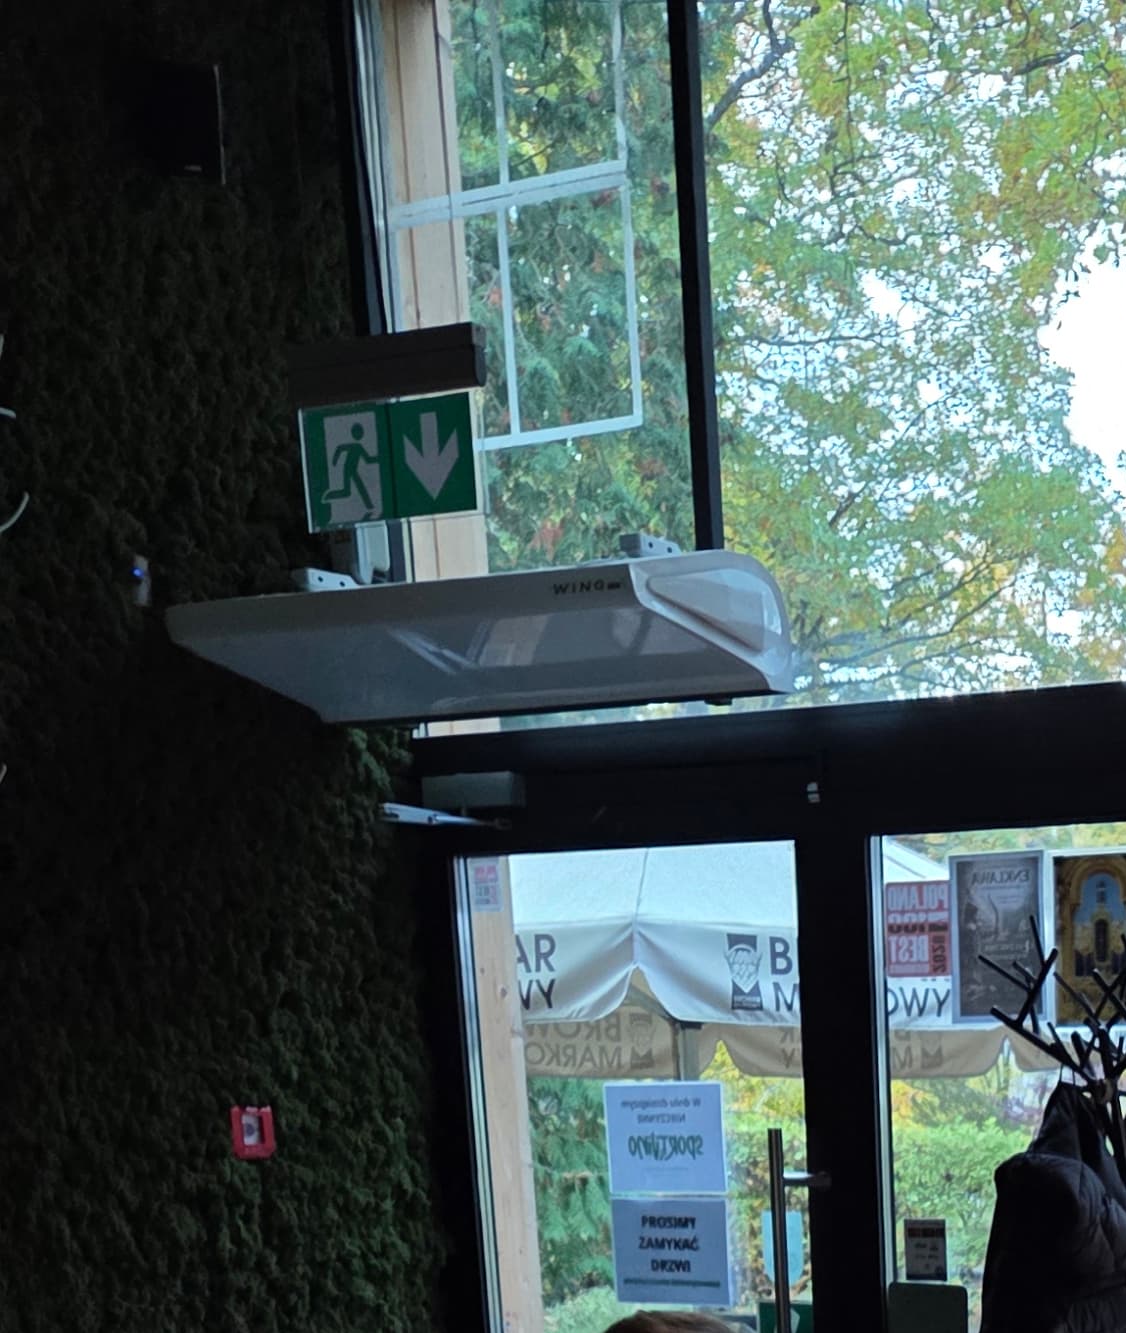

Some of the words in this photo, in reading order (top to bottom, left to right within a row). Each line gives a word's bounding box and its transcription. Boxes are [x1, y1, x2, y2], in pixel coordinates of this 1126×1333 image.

[641, 1215, 696, 1229] PROSIMY
[638, 1236, 699, 1252] ZAMYKAĆ
[651, 1259, 691, 1273] DRZWI
